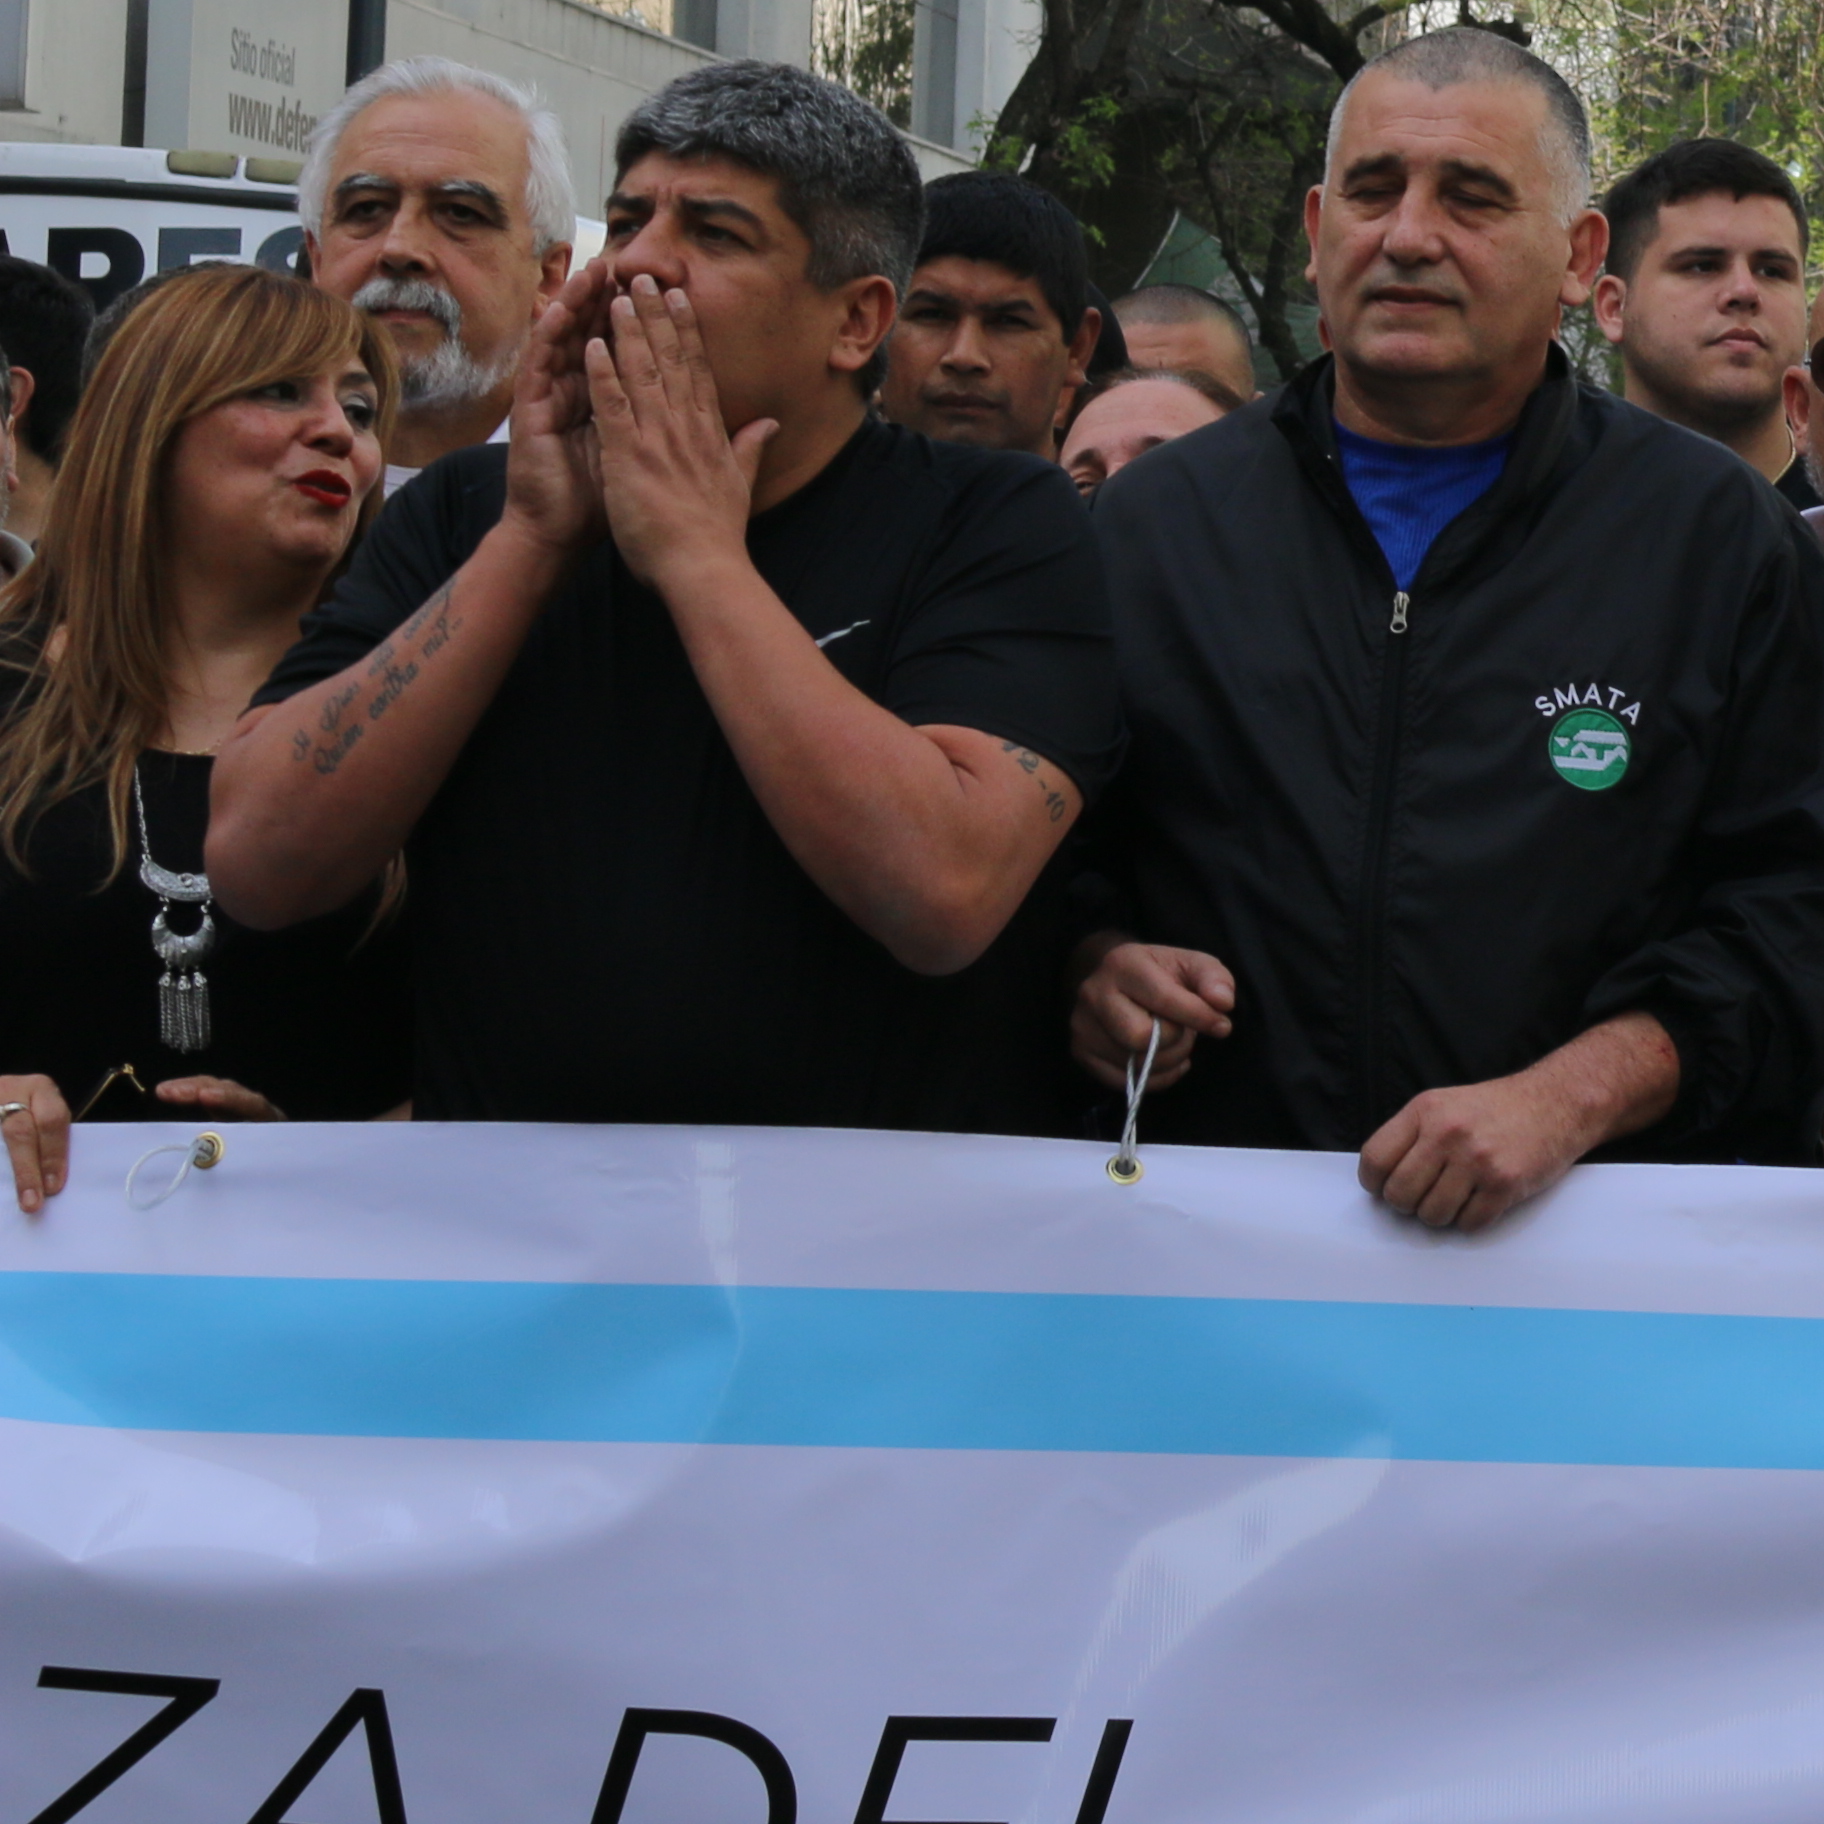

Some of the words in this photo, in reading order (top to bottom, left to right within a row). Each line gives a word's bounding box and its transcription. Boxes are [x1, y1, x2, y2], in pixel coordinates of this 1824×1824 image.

[230, 27, 257, 76] Sitio
[259, 39, 295, 87] oficial
[1535, 683, 1641, 725] SMATA
